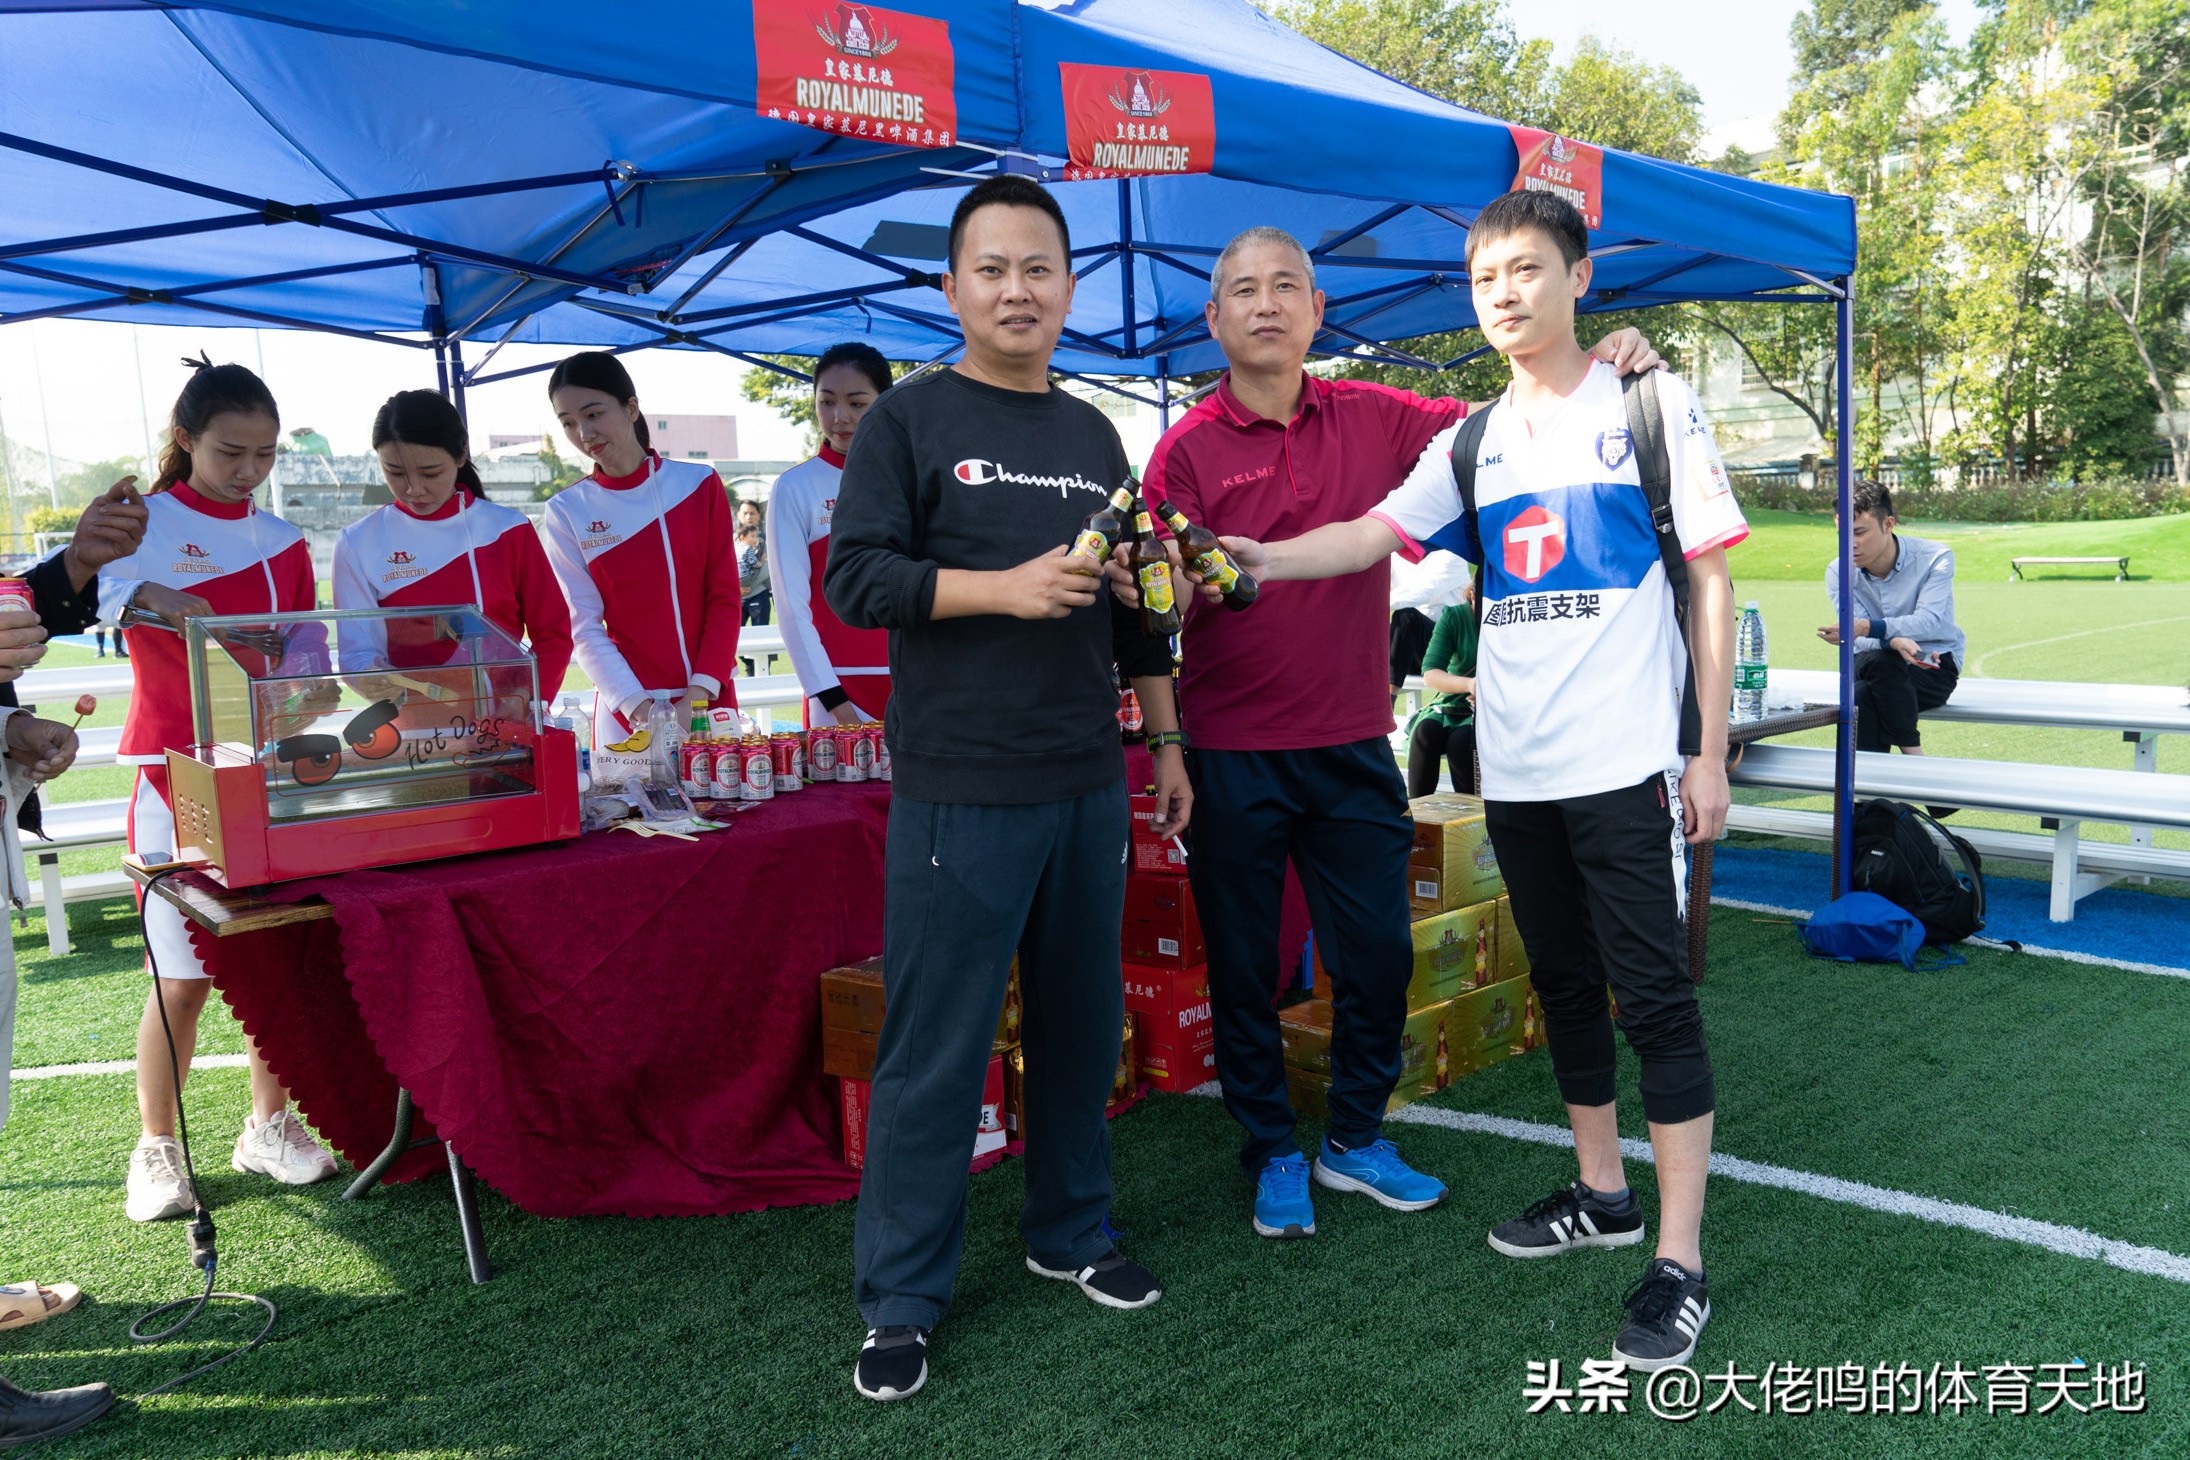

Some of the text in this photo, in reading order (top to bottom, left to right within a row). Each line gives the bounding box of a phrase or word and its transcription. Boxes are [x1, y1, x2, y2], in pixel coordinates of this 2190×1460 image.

[824, 58, 894, 87] 皇家慕尼德
[796, 78, 924, 124] ROYALMUNEDE
[1116, 121, 1169, 142] 皇家慕尼德
[1092, 142, 1189, 171] ROYALMUNEDE
[954, 459, 1108, 498] Champion
[1221, 466, 1276, 488] KELME
[405, 715, 504, 770] Hot Dogs
